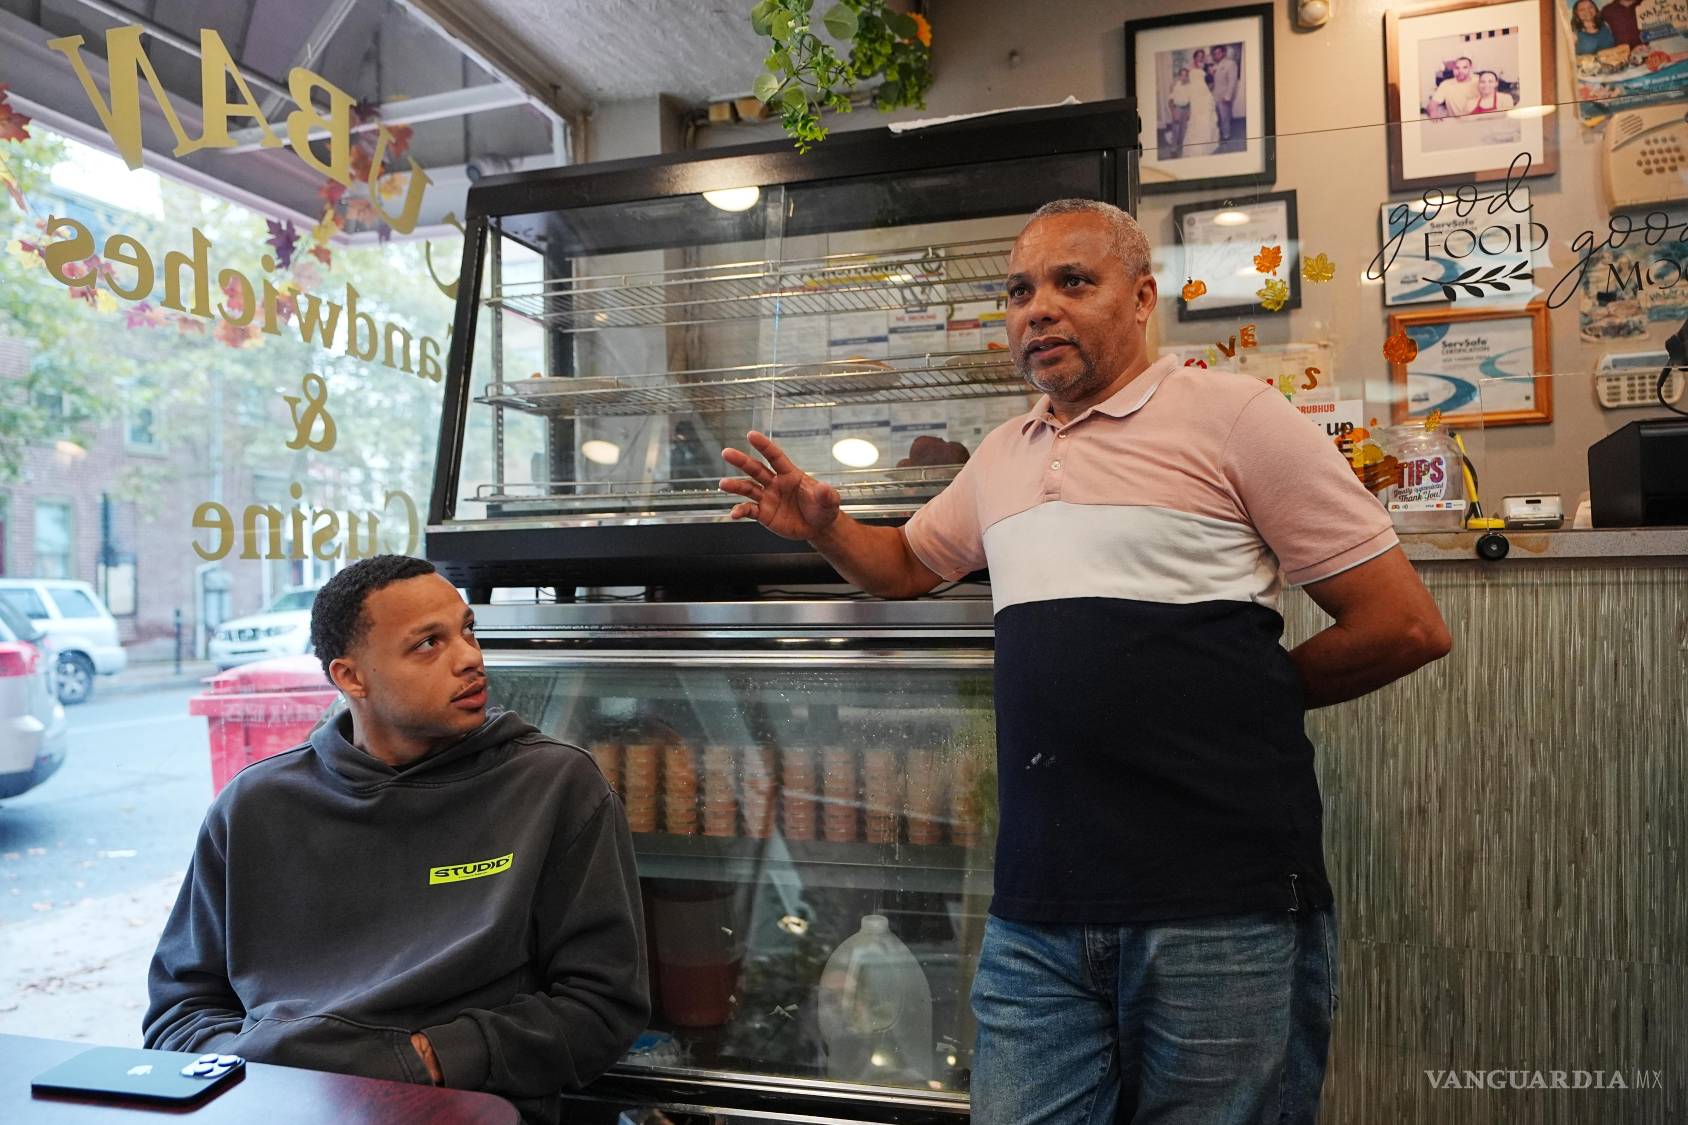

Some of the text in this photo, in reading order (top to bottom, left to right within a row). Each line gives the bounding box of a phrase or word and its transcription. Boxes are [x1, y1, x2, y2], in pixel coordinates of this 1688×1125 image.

[1367, 152, 1534, 280] good
[1424, 222, 1549, 261] FOOD
[1547, 211, 1688, 309] goo
[1606, 258, 1688, 291] MO
[1395, 456, 1444, 488] TIPS
[434, 858, 509, 877] STUDIO
